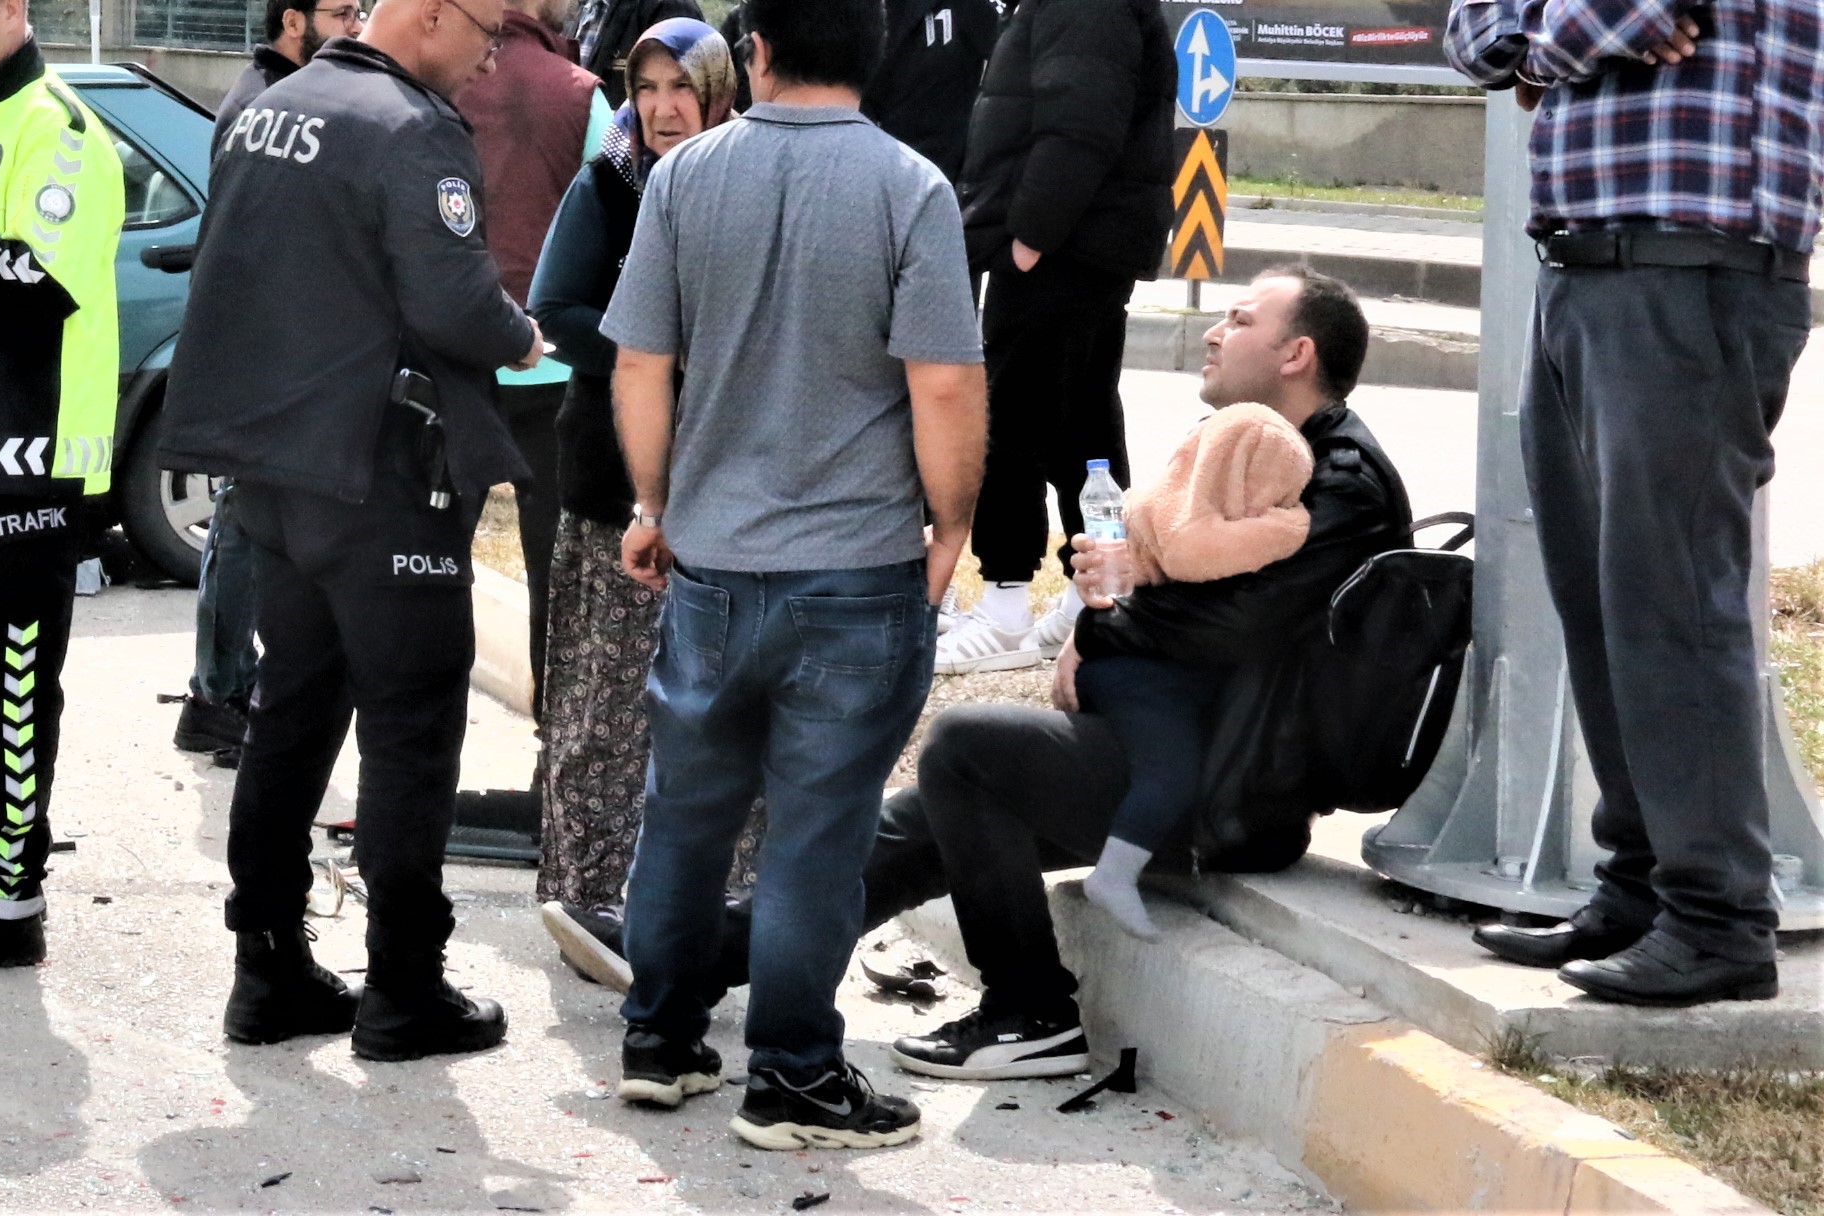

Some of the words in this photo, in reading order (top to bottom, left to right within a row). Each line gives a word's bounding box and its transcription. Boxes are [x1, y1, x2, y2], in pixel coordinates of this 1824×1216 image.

[1257, 24, 1304, 36] Muhittin
[1305, 23, 1345, 38] BÖCEK
[226, 108, 326, 164] POLİS
[392, 554, 459, 576] POLİS
